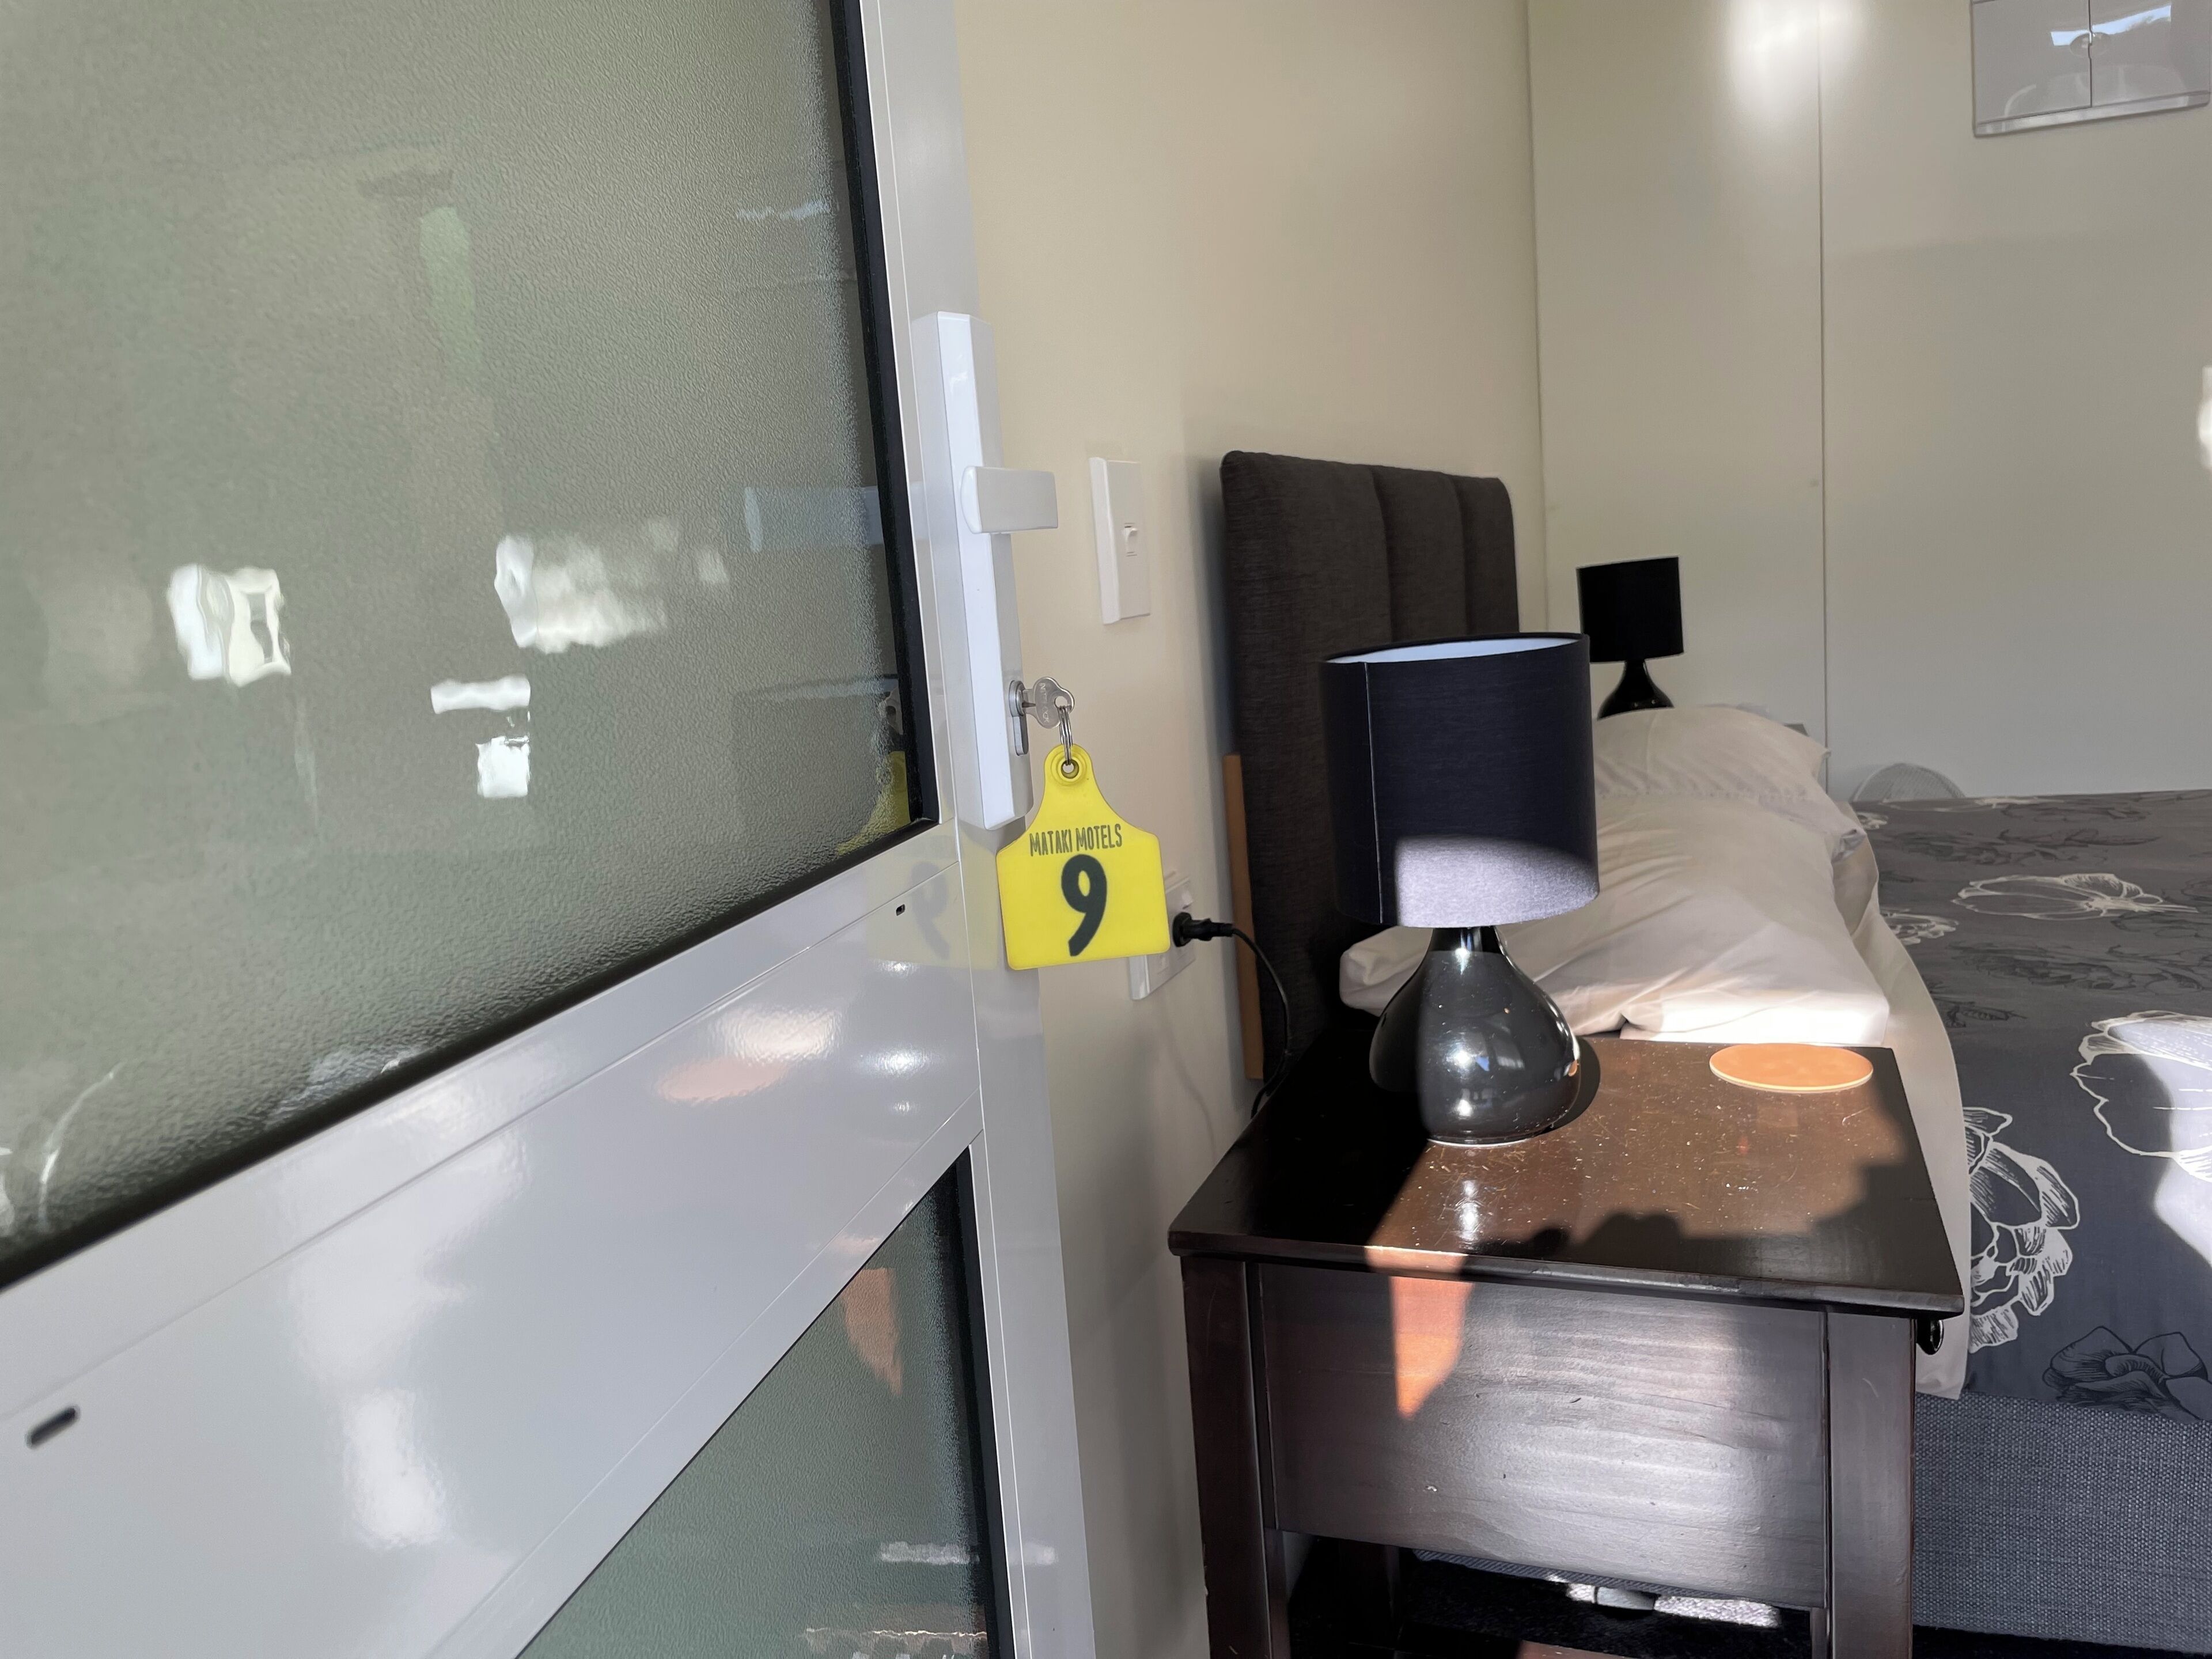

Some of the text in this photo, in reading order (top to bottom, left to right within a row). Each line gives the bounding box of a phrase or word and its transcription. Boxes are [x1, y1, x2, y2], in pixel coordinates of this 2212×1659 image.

[1029, 823, 1123, 857] MATAKI MOTELS
[1061, 854, 1107, 957] 9
